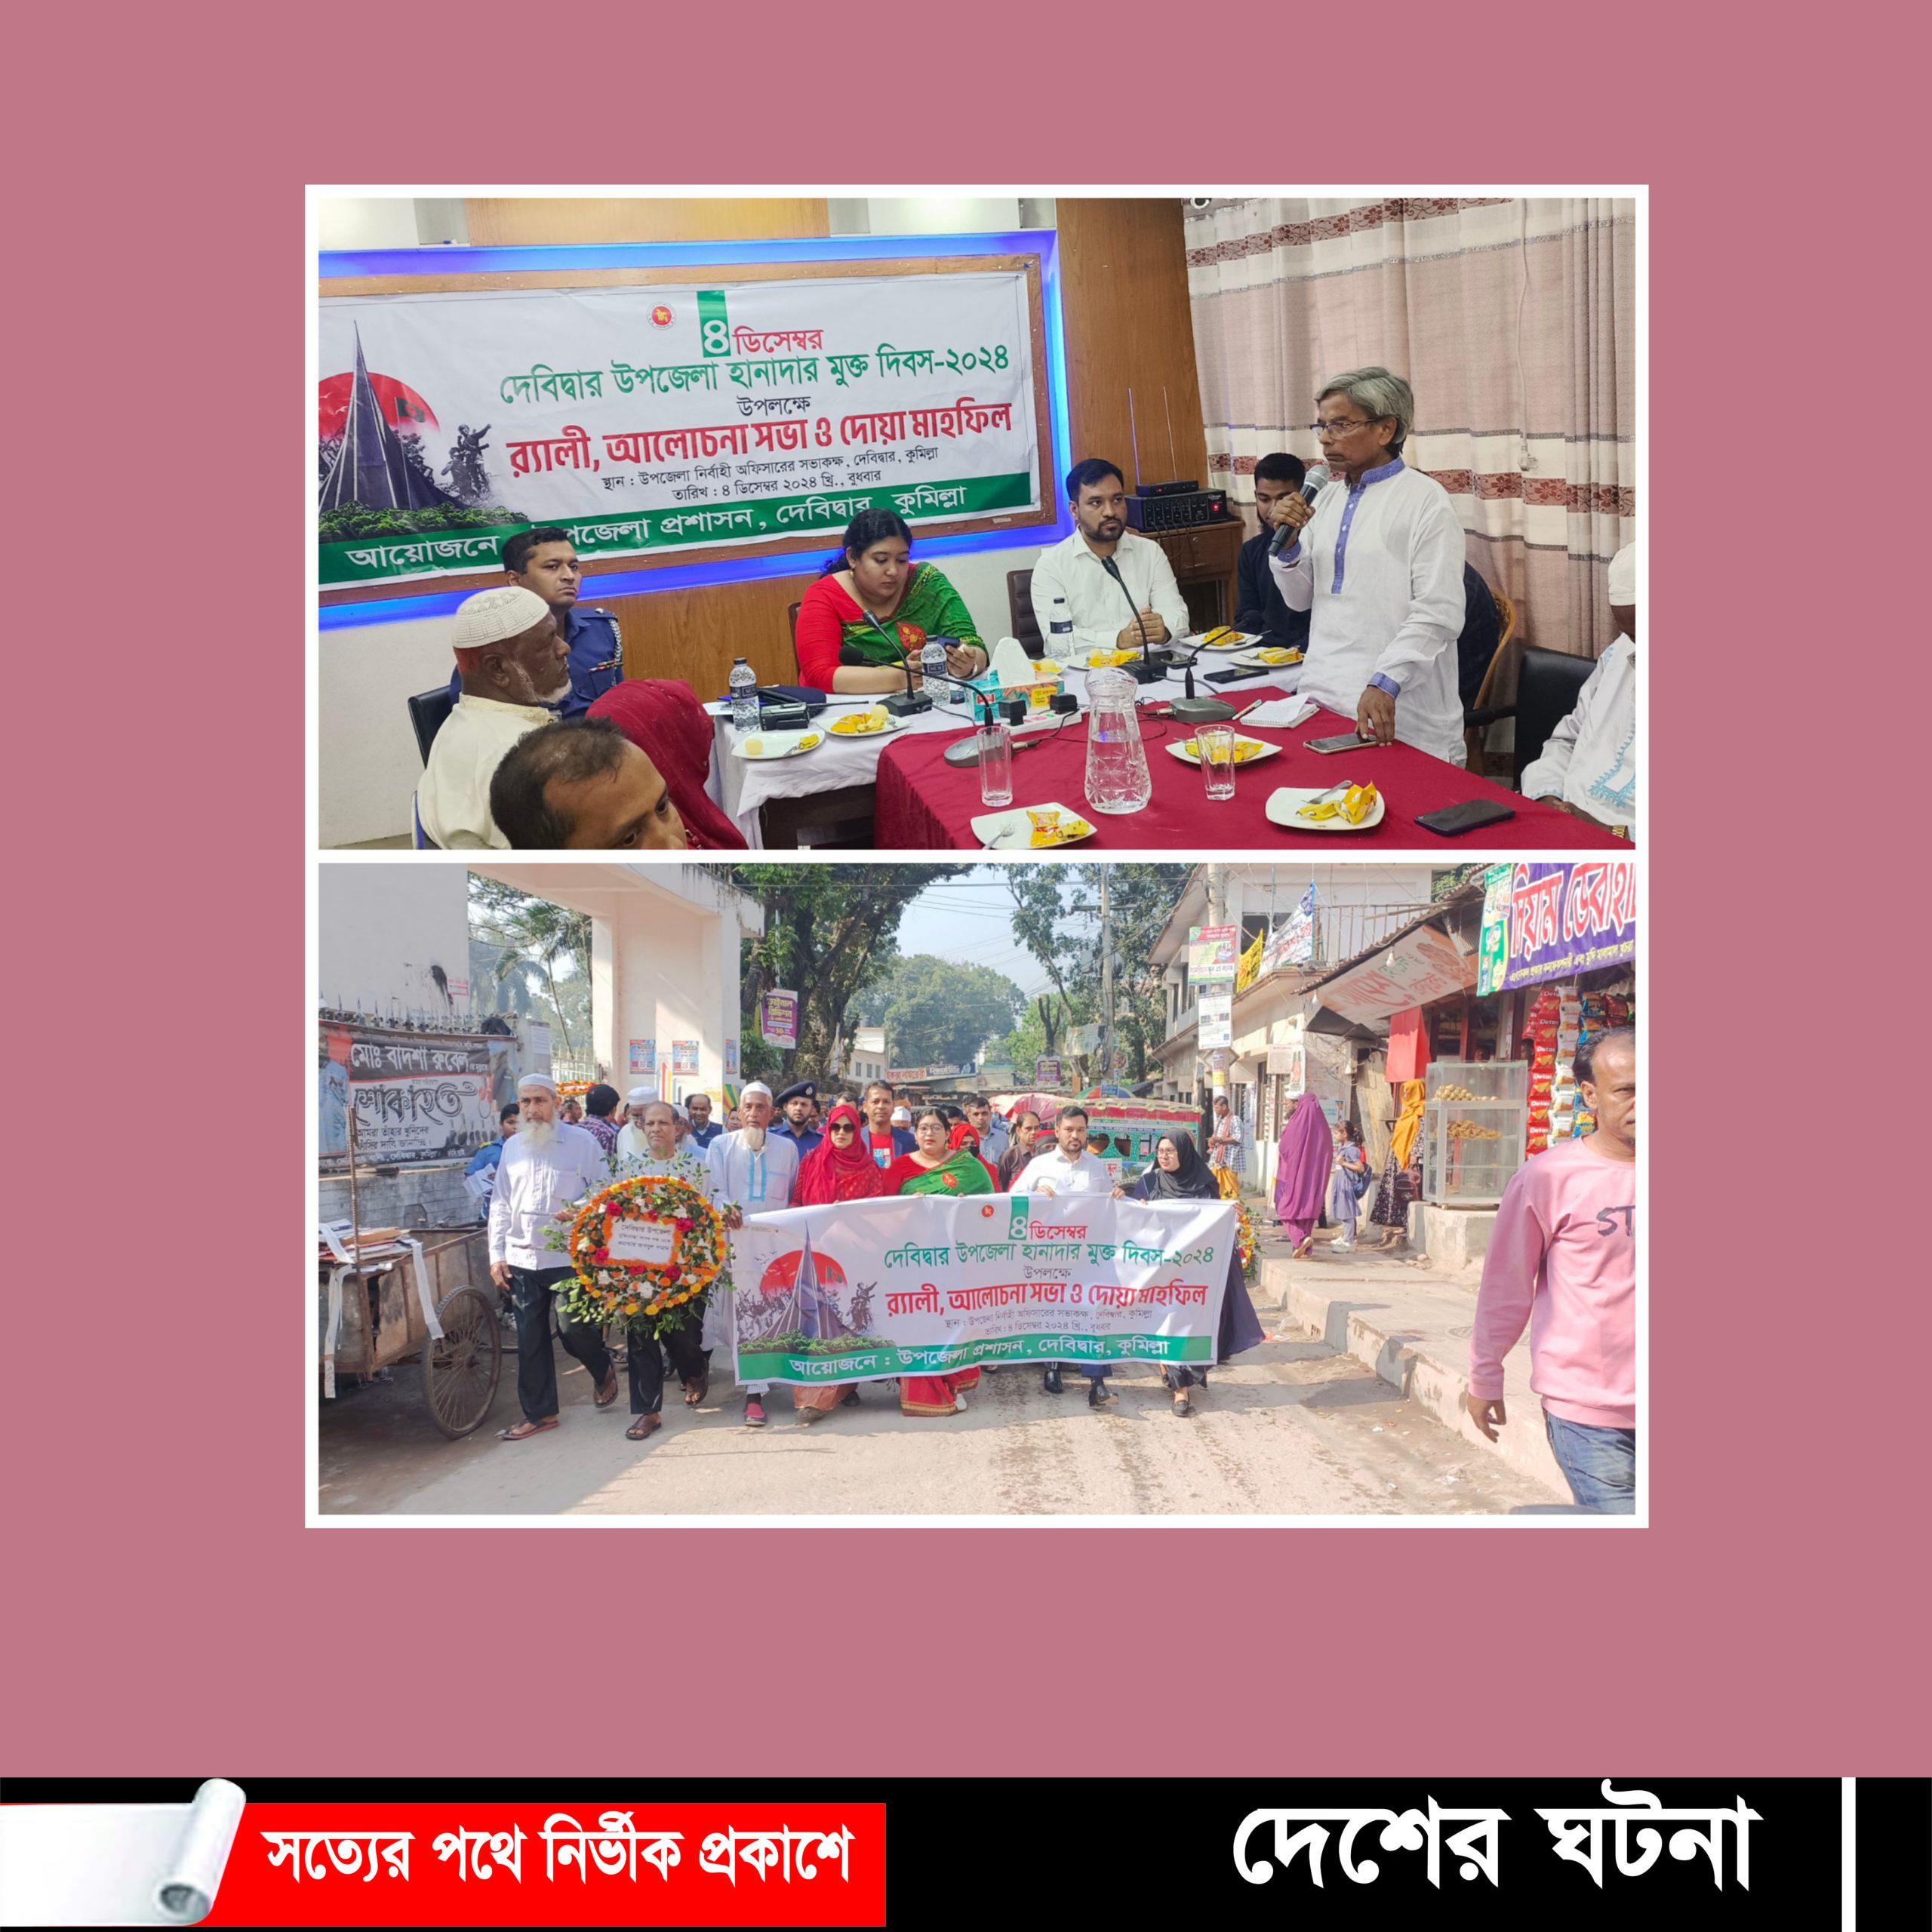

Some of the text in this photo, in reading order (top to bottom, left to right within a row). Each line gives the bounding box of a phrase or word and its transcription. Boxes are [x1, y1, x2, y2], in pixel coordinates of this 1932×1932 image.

[703, 320, 824, 355] ৪ ডিসেম্বর
[500, 343, 1009, 404] দেবিদ্বার উপজেলা হানাদার মুক্ত দিবস-২০২৪
[737, 395, 811, 416] উপলক্ষে
[602, 423, 748, 463] আলোচনা
[753, 419, 808, 451] সভা
[815, 416, 832, 447] ও
[840, 411, 906, 445] দোয়া
[909, 396, 1012, 438] মাহফিল
[602, 476, 624, 491] স্থান
[638, 470, 690, 485] উপজেলা
[694, 463, 731, 481] নির্বাহী
[736, 460, 795, 476] অফিসারের
[906, 445, 938, 463] কুমিল্লা
[672, 485, 708, 500] তারিখ
[722, 485, 730, 496] ৪
[734, 479, 778, 495] ডিসেম্বর
[783, 476, 817, 491] ২০২৪
[848, 470, 881, 486] বুধবার
[345, 535, 499, 568] আয়োজনে
[891, 485, 967, 515] কুমিল্লা
[351, 1043, 382, 1069] মোঃ
[386, 1045, 428, 1070] বাদশা
[430, 1049, 469, 1072] রুবেল
[354, 1081, 478, 1127] শোকাহত
[1010, 1216, 1088, 1240] ৪ ডিসেম্বর
[884, 1240, 1214, 1268] দেবিদ্বার উপজেলা হানাদার মুক্ত দিবস-২০২৪
[1023, 1266, 1072, 1280] উপলক্ষে
[946, 1284, 1028, 1311] আলোচনা
[1029, 1283, 1067, 1303] সভা
[1070, 1284, 1083, 1303] ও
[1089, 1285, 1137, 1309] দোয়া
[1139, 1278, 1208, 1306] মাহফিল
[1014, 1321, 1042, 1331] ডিসেম্বর
[1045, 1322, 1069, 1331] ২০২৪
[1018, 1309, 1055, 1318] অফিসারের
[790, 1355, 878, 1376] আয়োজনে
[897, 1346, 968, 1365] উপজেলা
[1038, 1336, 1111, 1356] দেবিদ্বার,
[1116, 1335, 1171, 1355] কুমিল্লা
